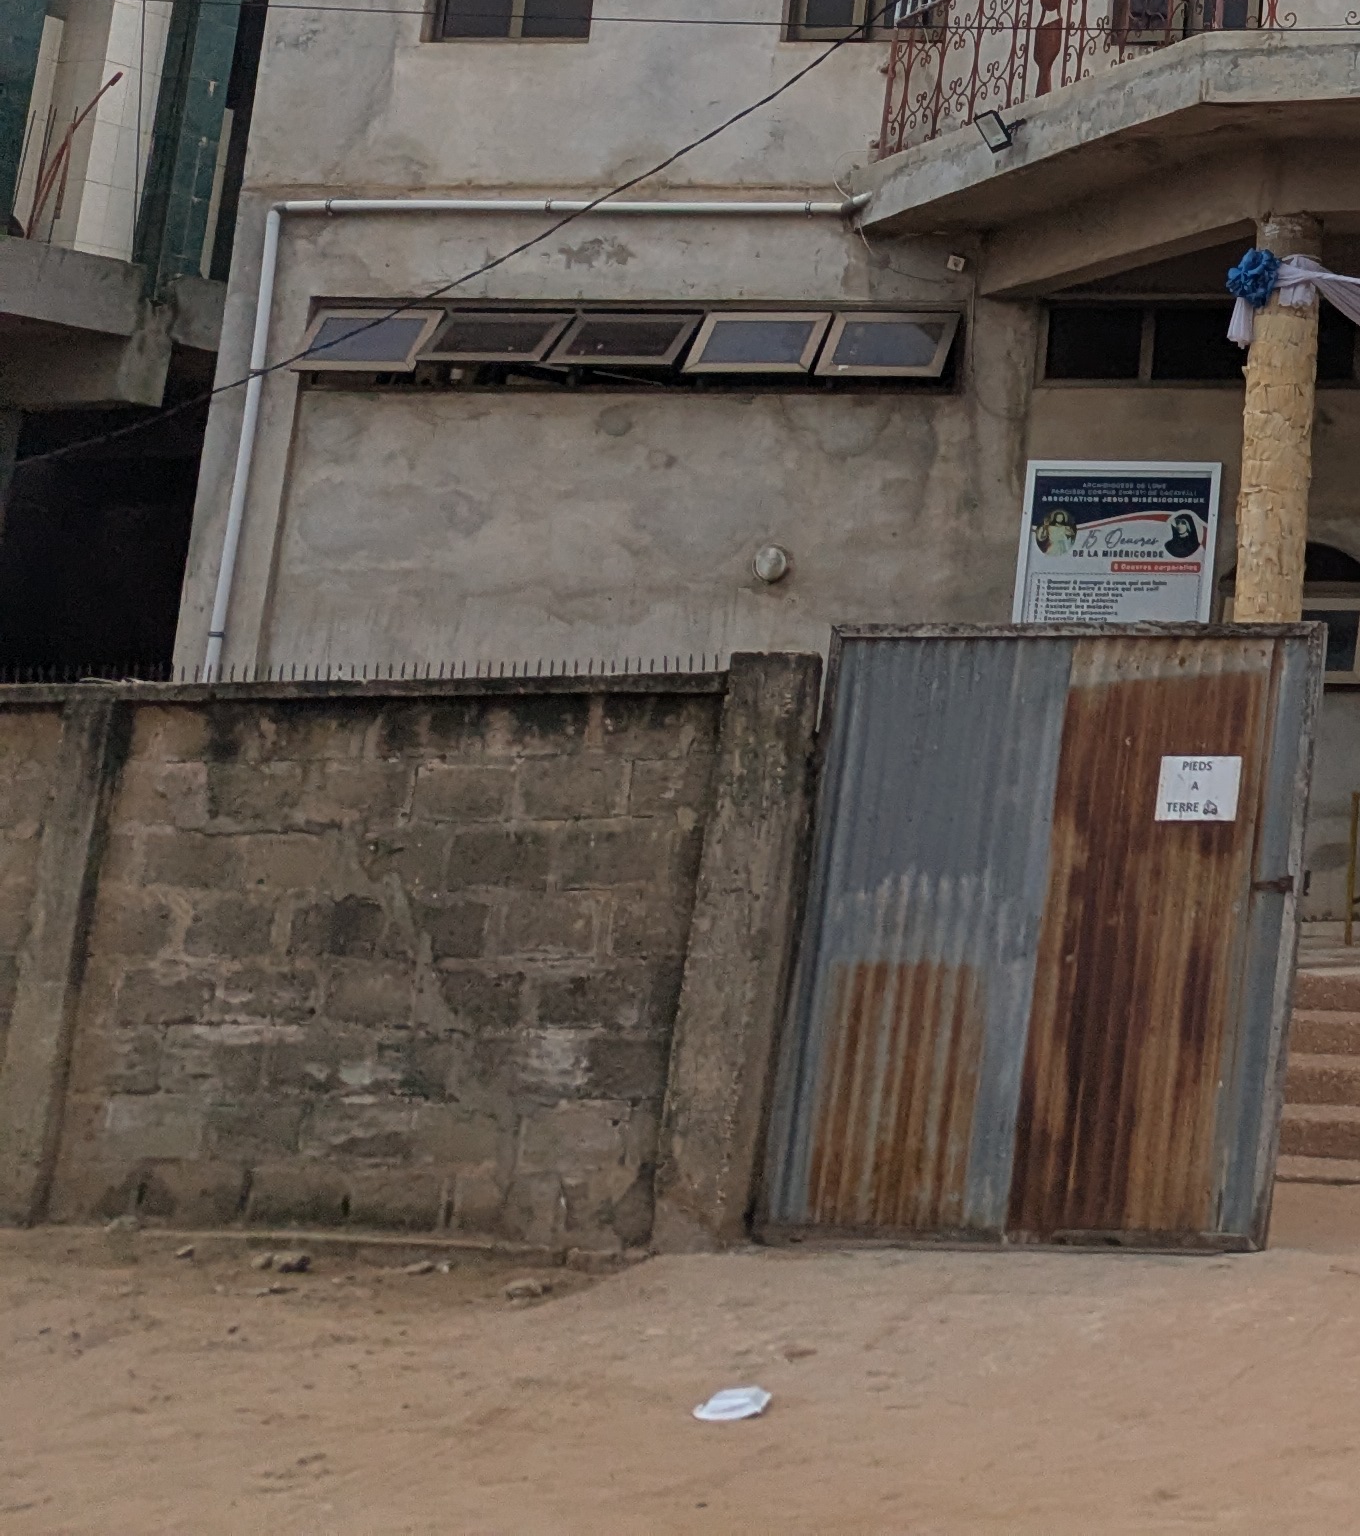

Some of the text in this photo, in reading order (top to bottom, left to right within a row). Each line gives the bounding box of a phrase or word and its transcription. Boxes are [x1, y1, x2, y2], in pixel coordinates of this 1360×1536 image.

[1041, 495, 1100, 503] ASSOCIATION
[1081, 528, 1159, 549] 15 Oeuvres
[1072, 549, 1165, 559] DE LA MISÉRICORDE
[1120, 563, 1153, 571] Oeuvres
[1182, 760, 1213, 772] PIEDS
[1190, 781, 1200, 791] A
[1166, 801, 1200, 813] TERRE
